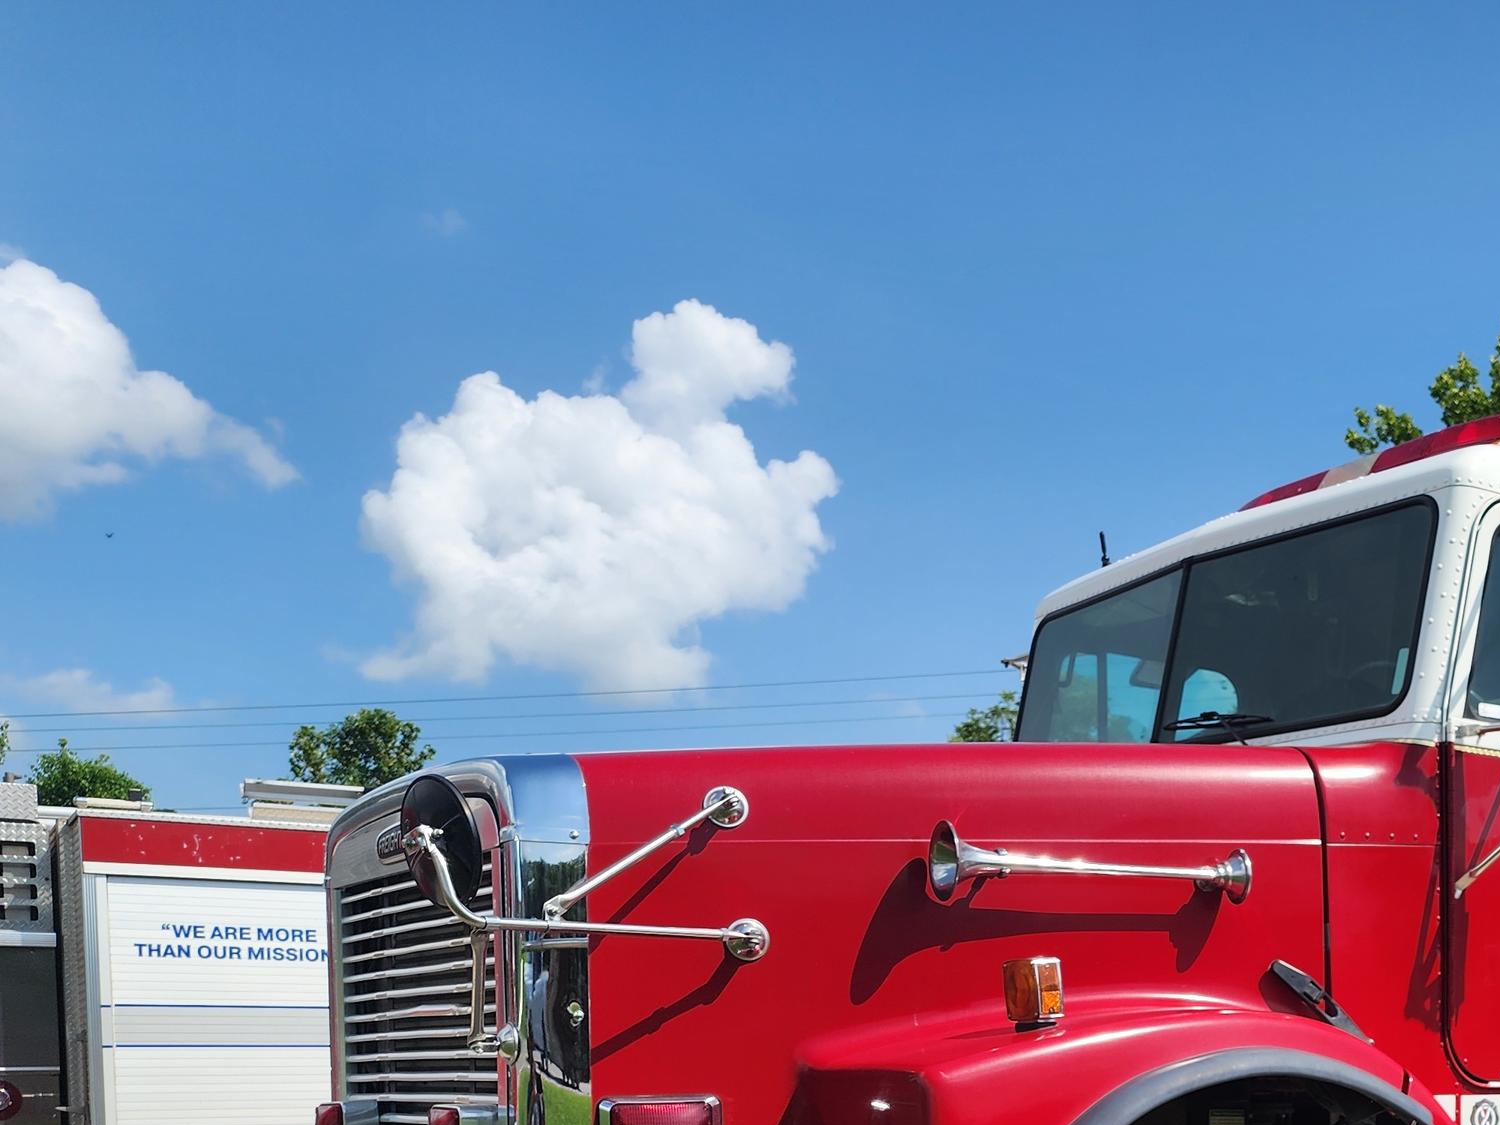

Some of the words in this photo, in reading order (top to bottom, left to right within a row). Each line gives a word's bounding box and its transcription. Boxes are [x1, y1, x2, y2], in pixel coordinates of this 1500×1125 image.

[210, 926, 251, 941] ARE
[257, 927, 317, 943] MORE
[134, 943, 191, 958] THAN
[197, 945, 241, 960] OUR
